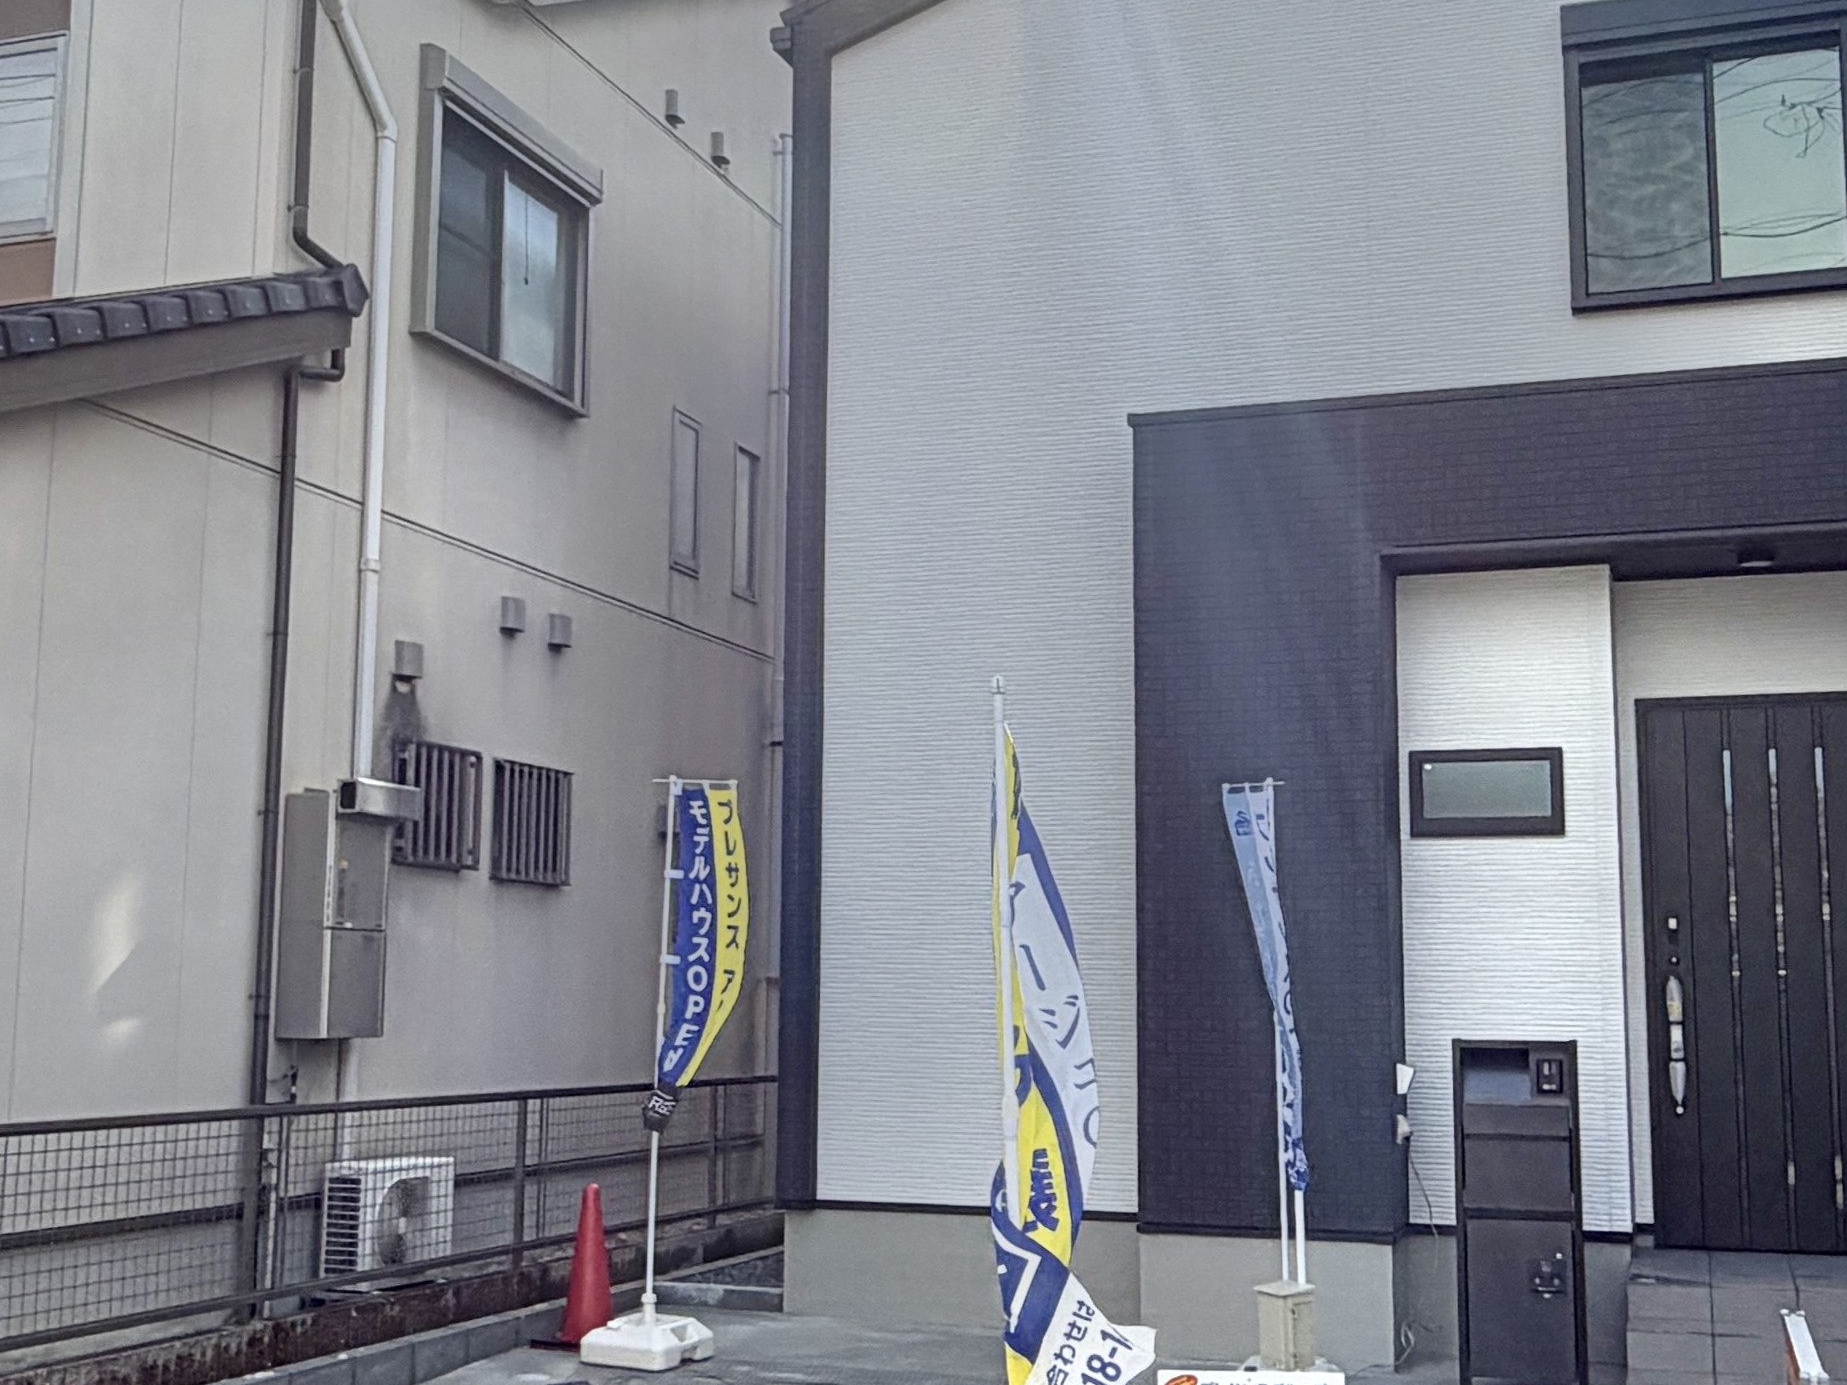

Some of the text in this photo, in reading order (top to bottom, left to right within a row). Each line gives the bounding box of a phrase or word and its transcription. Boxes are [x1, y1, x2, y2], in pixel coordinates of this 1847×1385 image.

[717, 799, 742, 949] プレサンス
